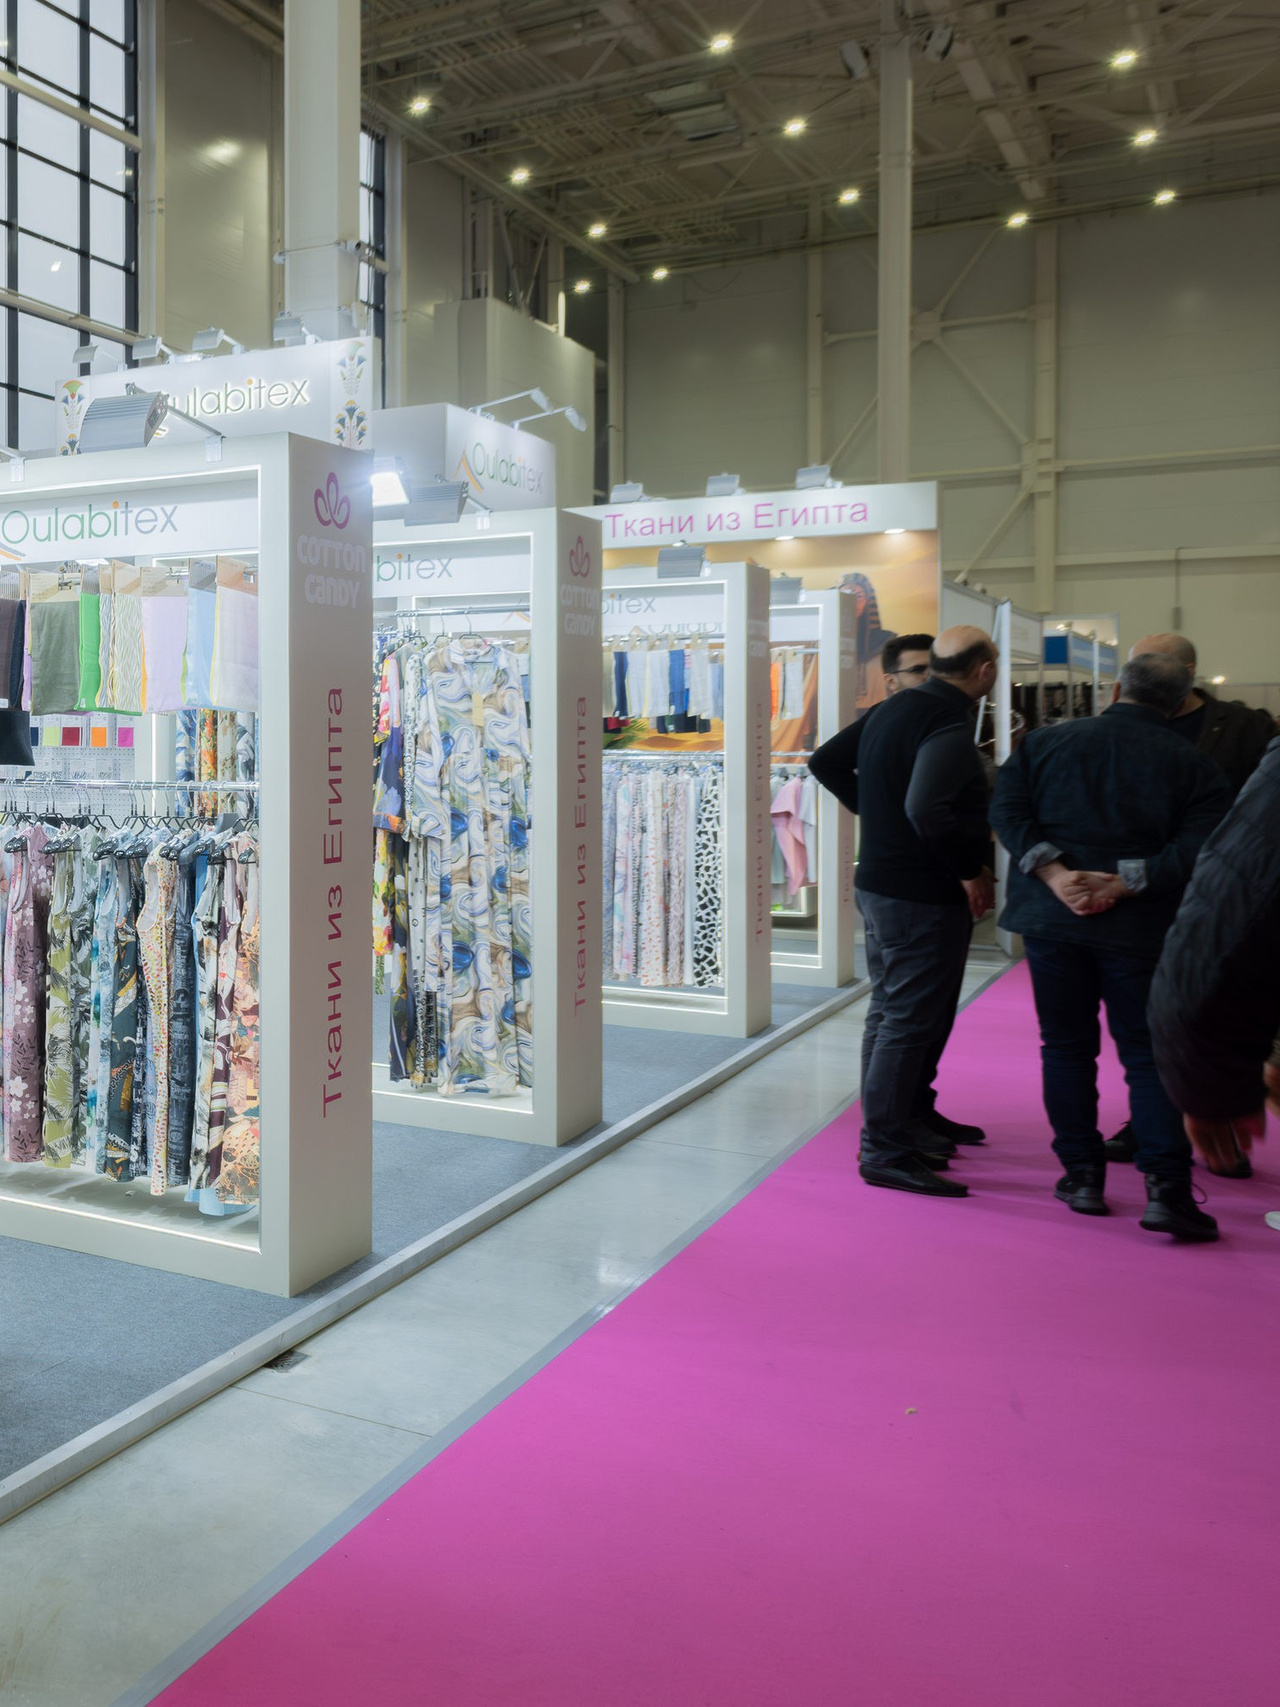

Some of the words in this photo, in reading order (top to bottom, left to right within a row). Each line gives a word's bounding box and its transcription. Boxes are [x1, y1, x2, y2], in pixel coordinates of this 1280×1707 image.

[1, 500, 179, 544] Oulabitex
[605, 513, 694, 538] Ткани
[706, 511, 741, 531] из
[754, 501, 869, 528] Египта
[323, 688, 343, 865] Египта
[328, 884, 343, 940] из
[574, 901, 587, 1017] Ткани
[323, 961, 343, 1118] Ткани
